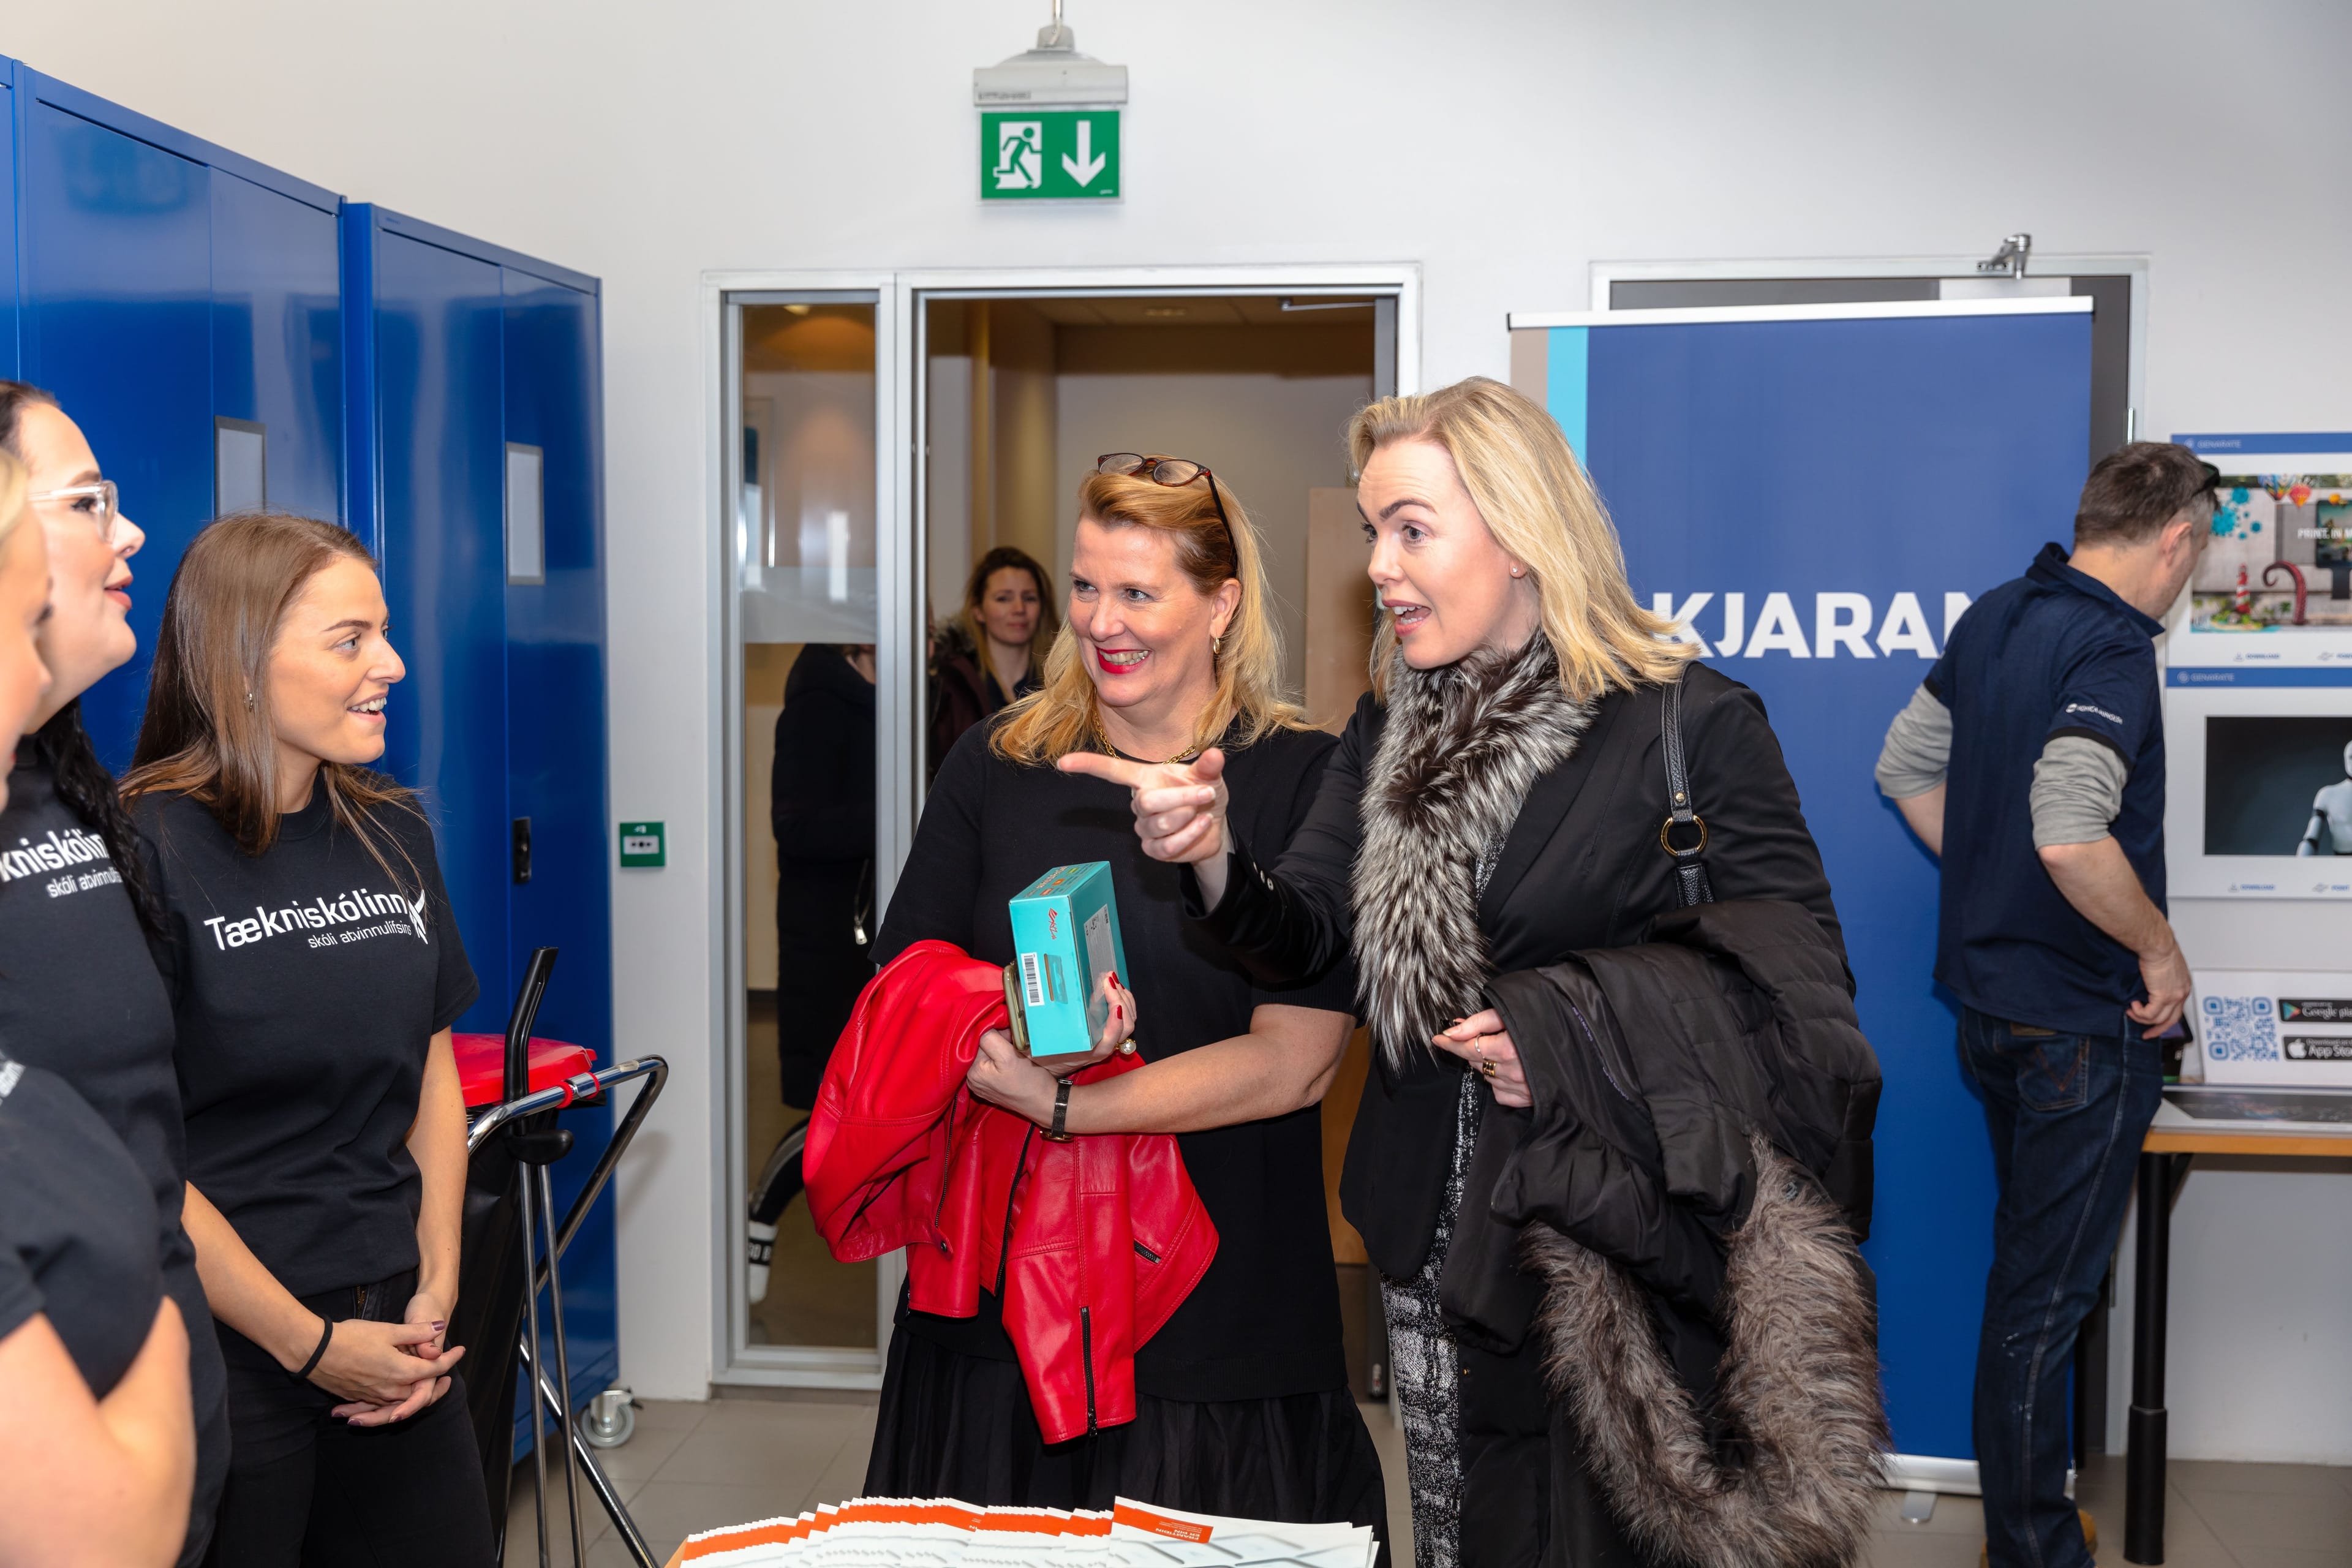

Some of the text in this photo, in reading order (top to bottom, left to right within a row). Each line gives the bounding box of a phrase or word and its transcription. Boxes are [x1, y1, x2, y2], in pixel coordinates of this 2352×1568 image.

[203, 888, 409, 951] Tækniskólinn
[308, 920, 412, 949] skóli atvinnulífsins
